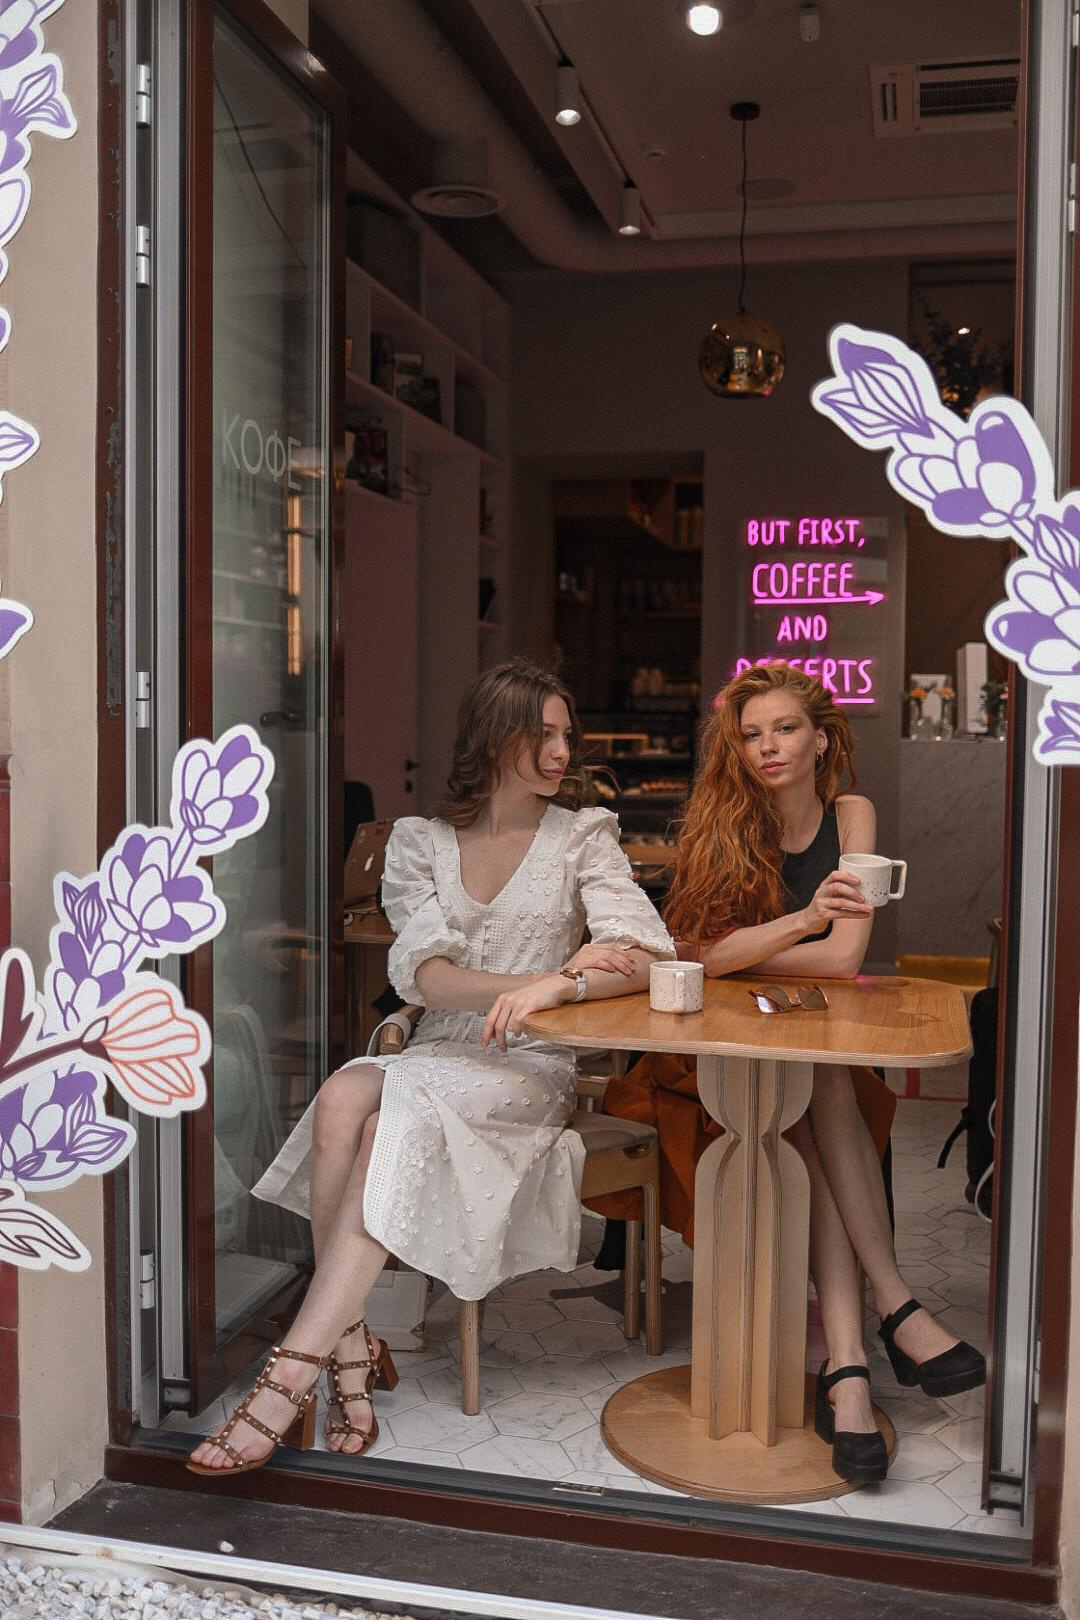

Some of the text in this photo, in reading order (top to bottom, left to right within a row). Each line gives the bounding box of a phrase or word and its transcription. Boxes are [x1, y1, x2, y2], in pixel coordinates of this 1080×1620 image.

[222, 408, 302, 491] КОФЕ
[747, 518, 865, 547] BUT FIRST,
[752, 562, 854, 598] COFFEE
[777, 614, 828, 641] AND
